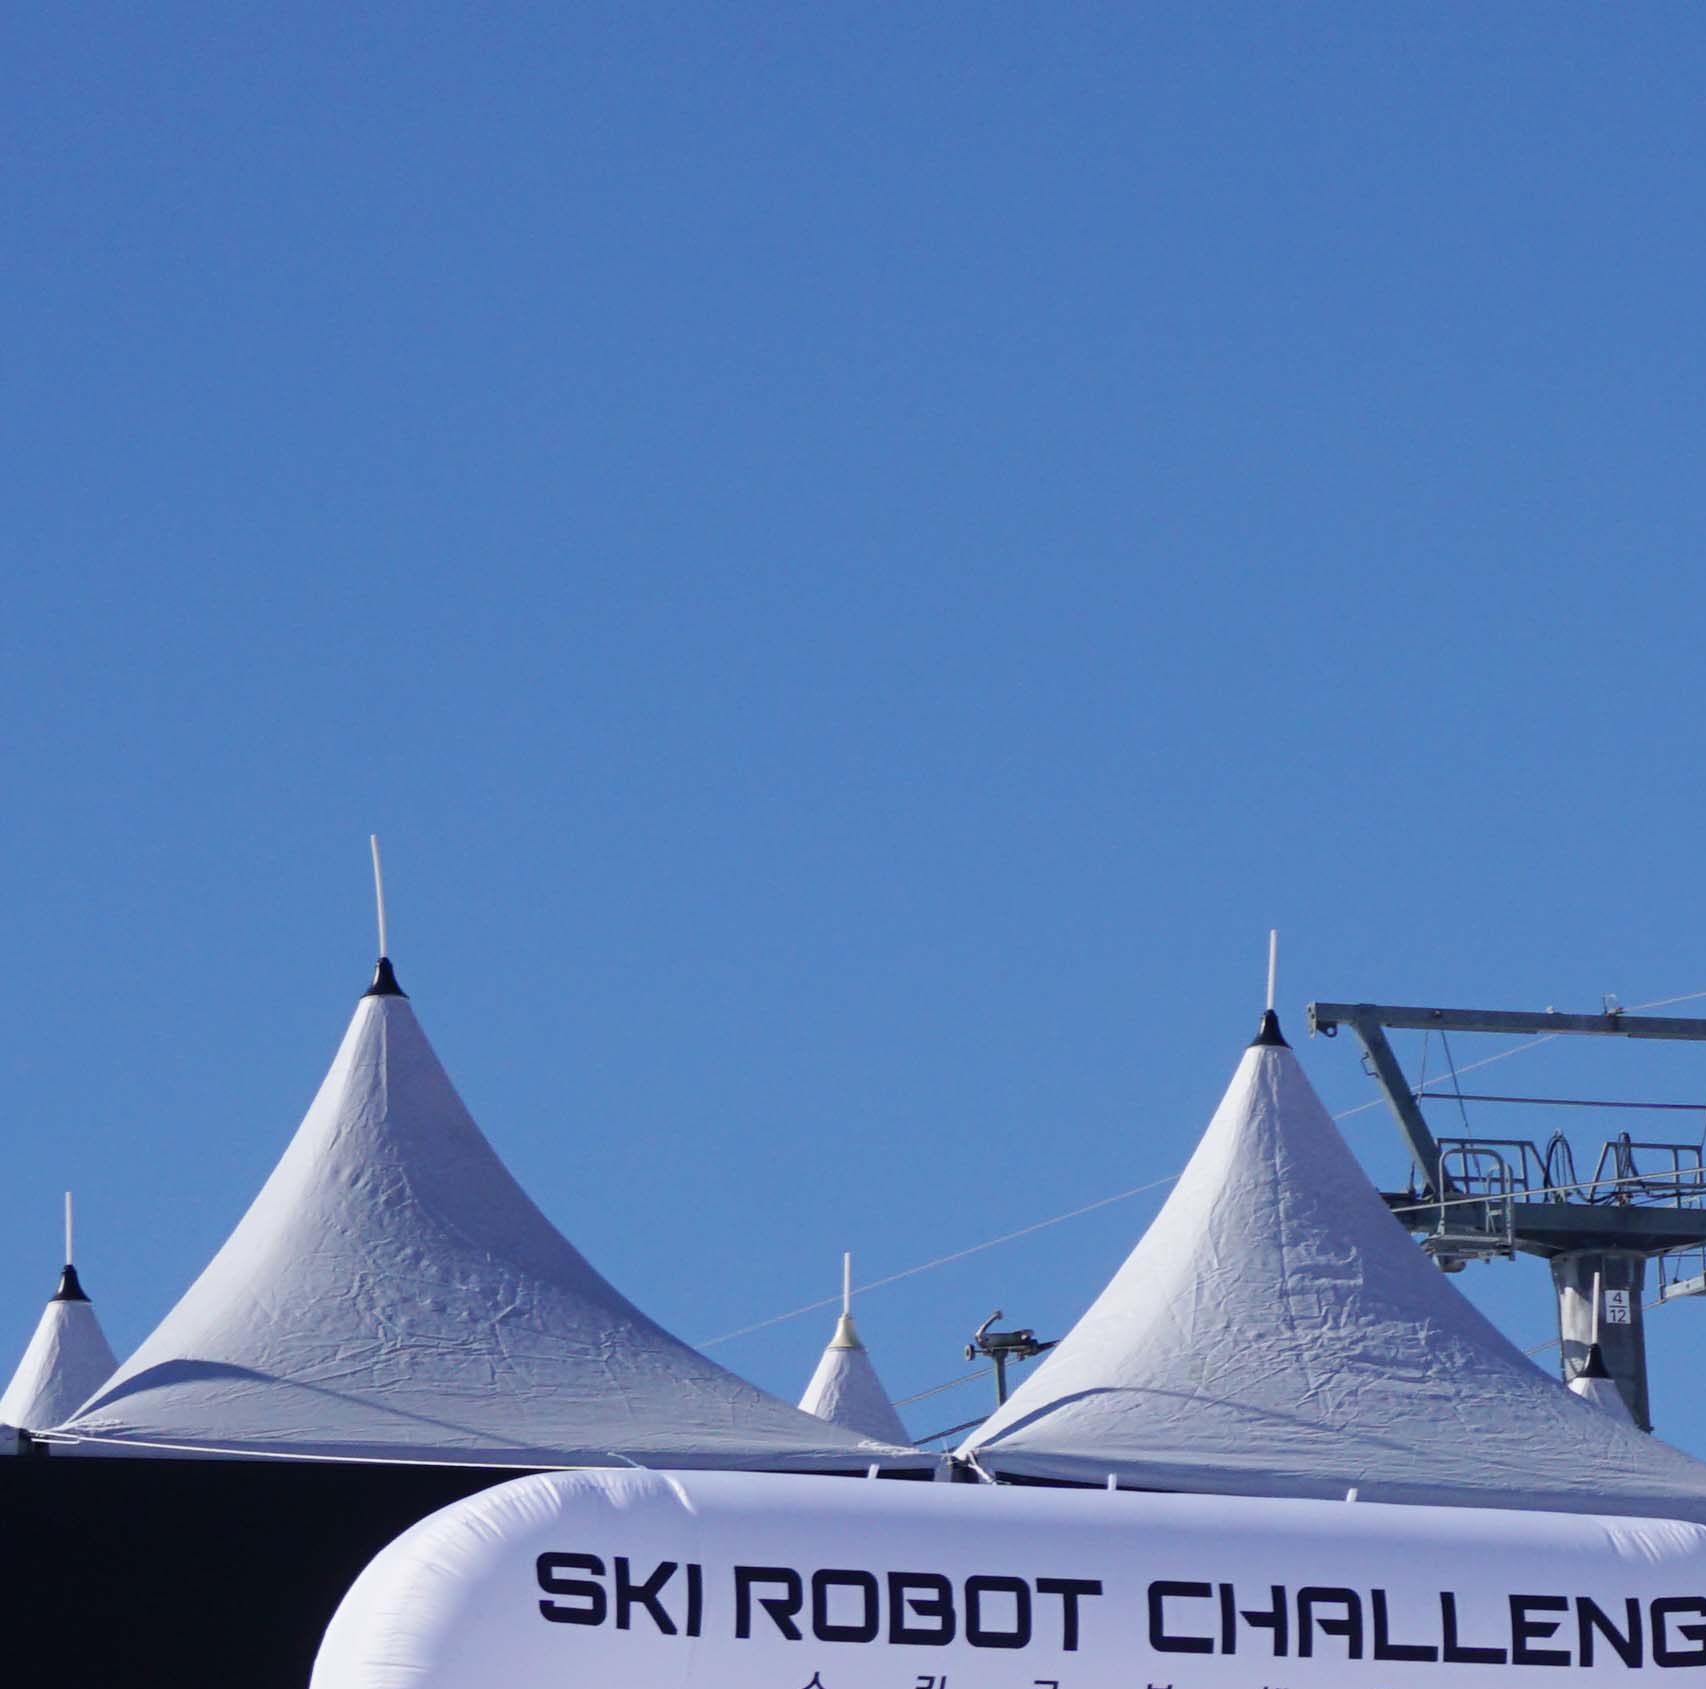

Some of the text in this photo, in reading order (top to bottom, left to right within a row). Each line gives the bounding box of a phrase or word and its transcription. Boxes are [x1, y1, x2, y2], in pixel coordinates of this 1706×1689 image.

[1613, 1292, 1622, 1304] 4
[1610, 1309, 1626, 1322] 12
[536, 1551, 703, 1637] SKI
[733, 1566, 1103, 1651] ROBOT
